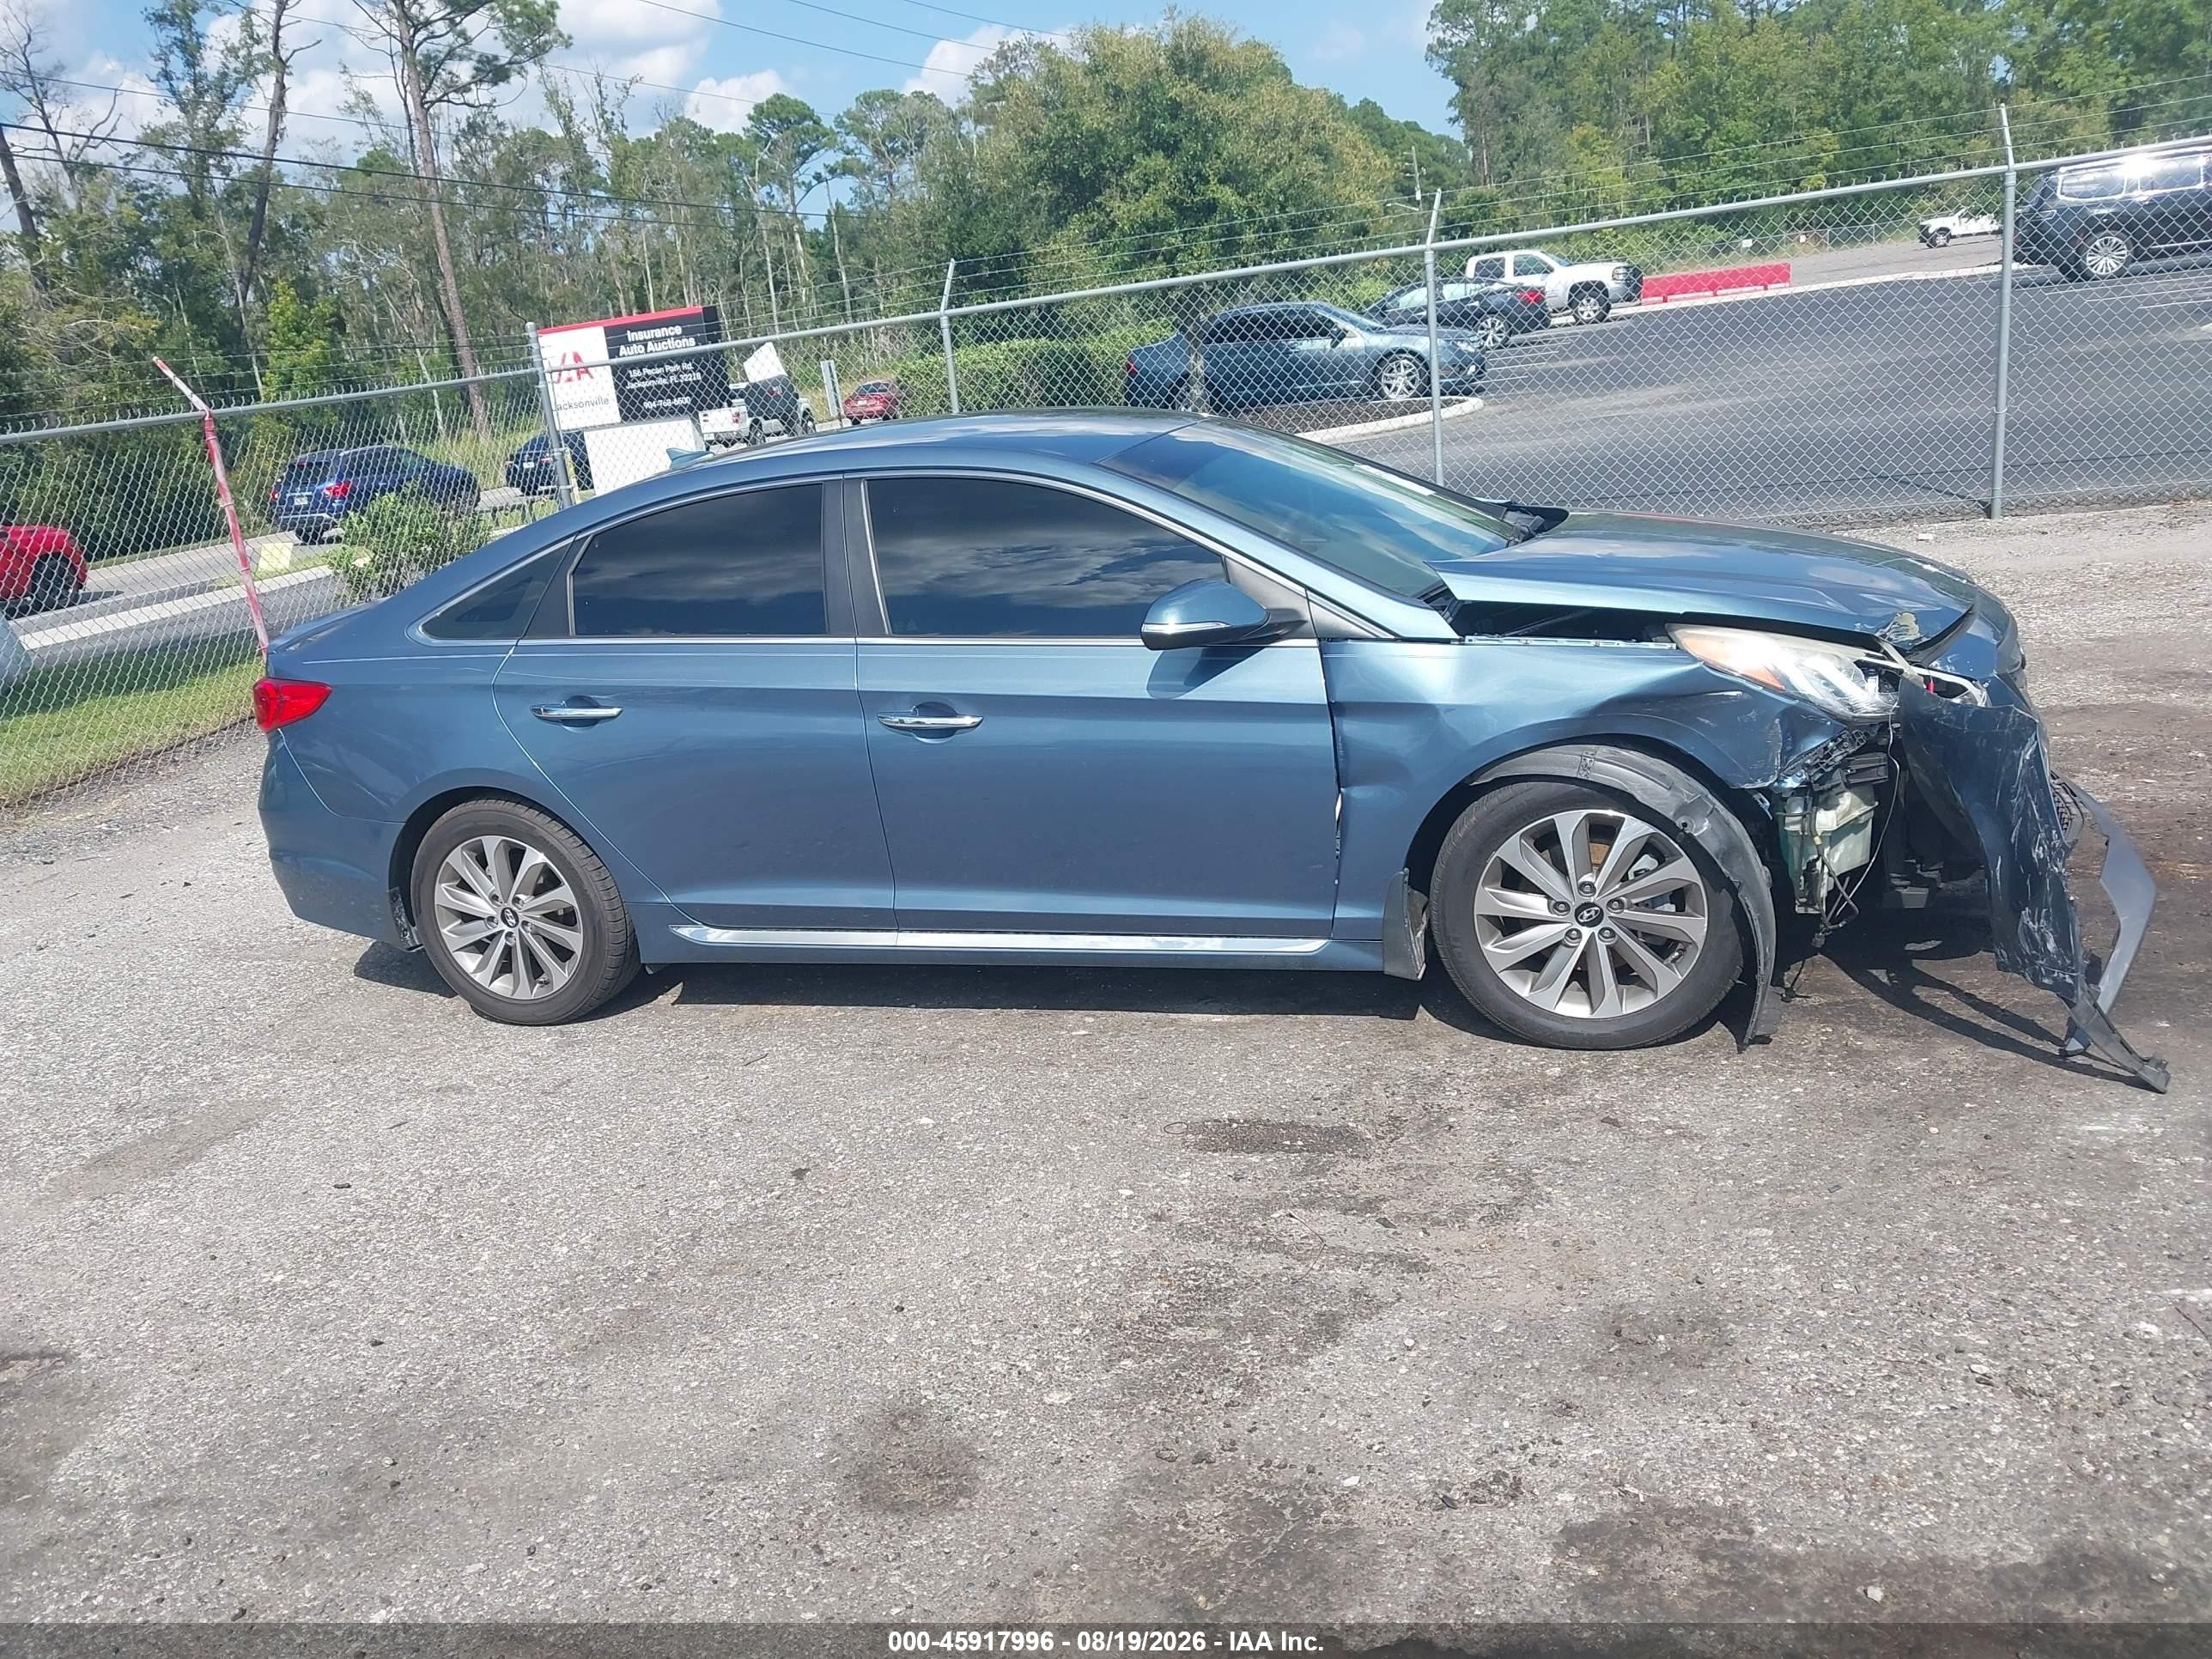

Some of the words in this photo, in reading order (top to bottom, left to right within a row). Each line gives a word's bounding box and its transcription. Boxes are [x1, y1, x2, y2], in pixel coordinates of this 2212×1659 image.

[627, 325, 682, 342] Insurance
[619, 344, 645, 356] Auto
[647, 337, 696, 353] Auctions
[665, 364, 681, 373] Park
[556, 396, 610, 411] acksonville
